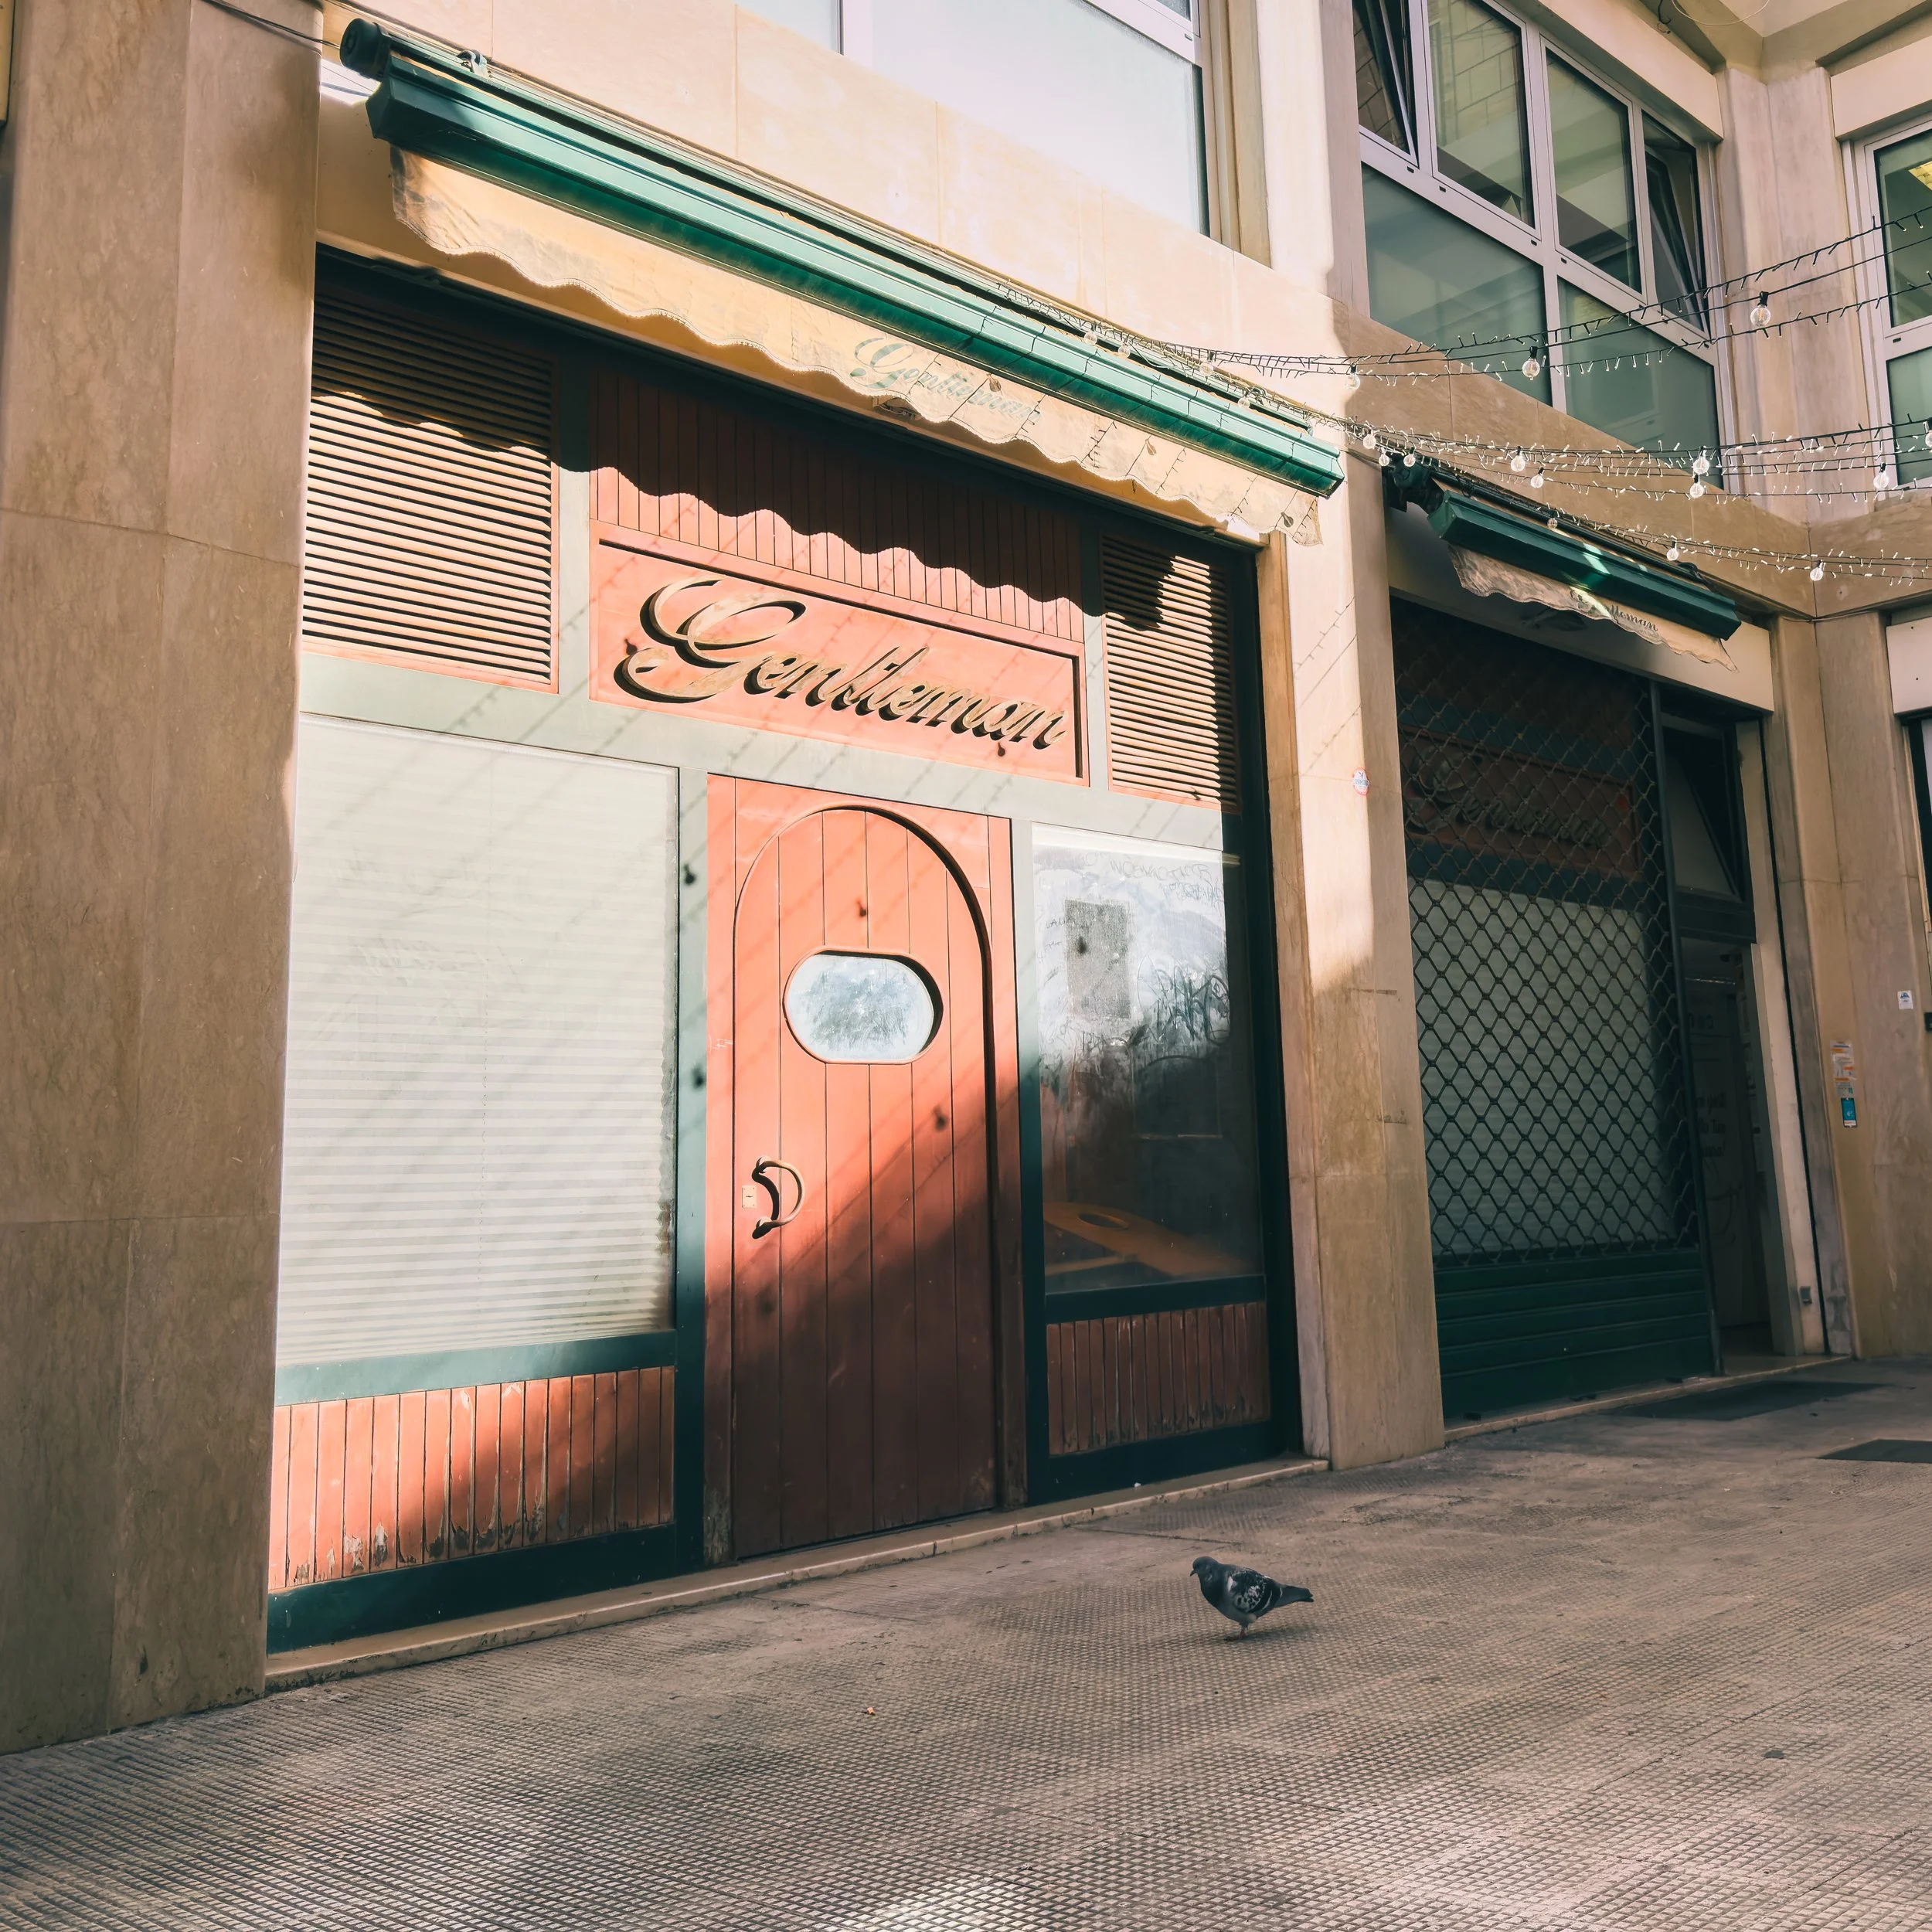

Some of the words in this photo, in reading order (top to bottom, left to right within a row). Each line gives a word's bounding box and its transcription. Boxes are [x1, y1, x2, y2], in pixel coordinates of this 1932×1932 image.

[850, 336, 1041, 423] Gentleman
[1570, 589, 1658, 632] Gtleman
[614, 575, 1067, 750] Gentleman
